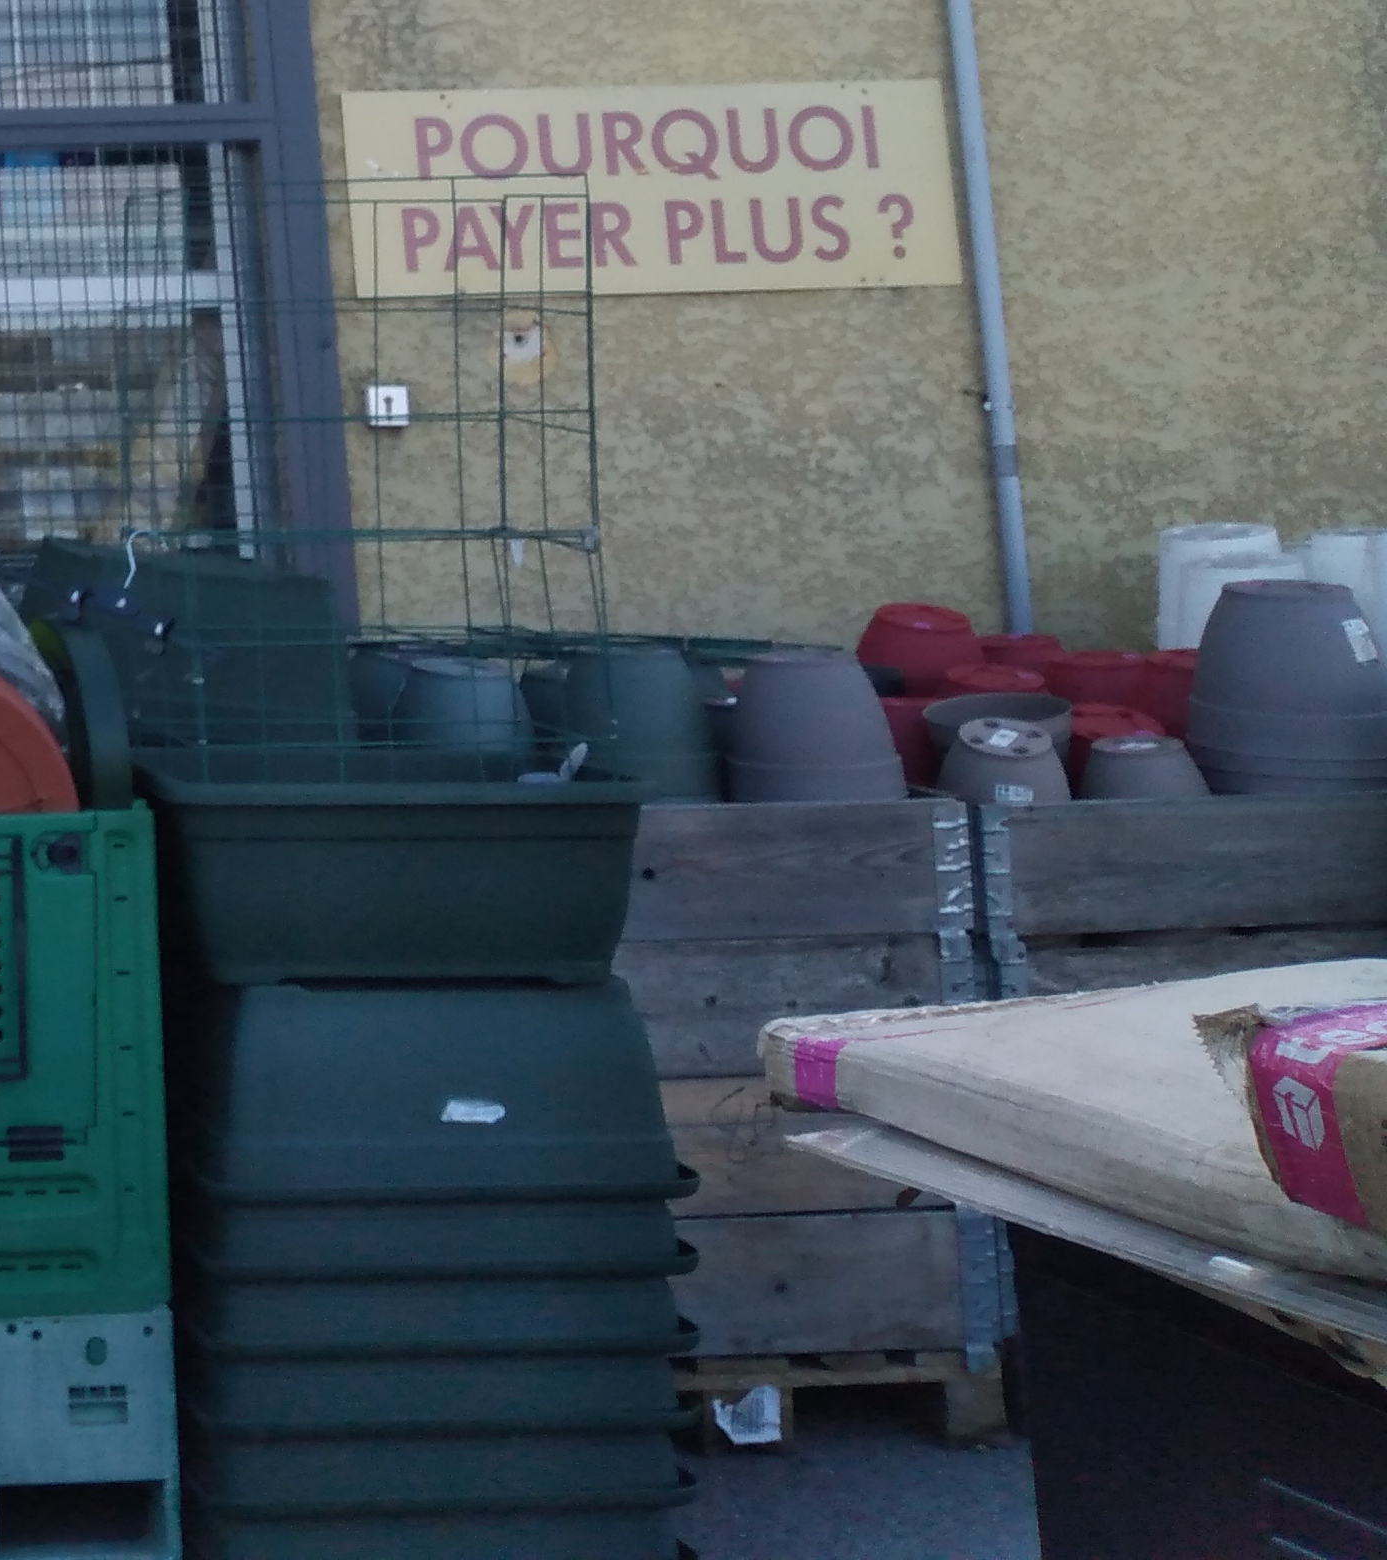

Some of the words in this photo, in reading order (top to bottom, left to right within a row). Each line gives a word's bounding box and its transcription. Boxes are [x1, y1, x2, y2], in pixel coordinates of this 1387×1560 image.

[413, 105, 880, 180] POURQUOI
[401, 201, 639, 273] PAYER
[664, 194, 851, 266] PLUS
